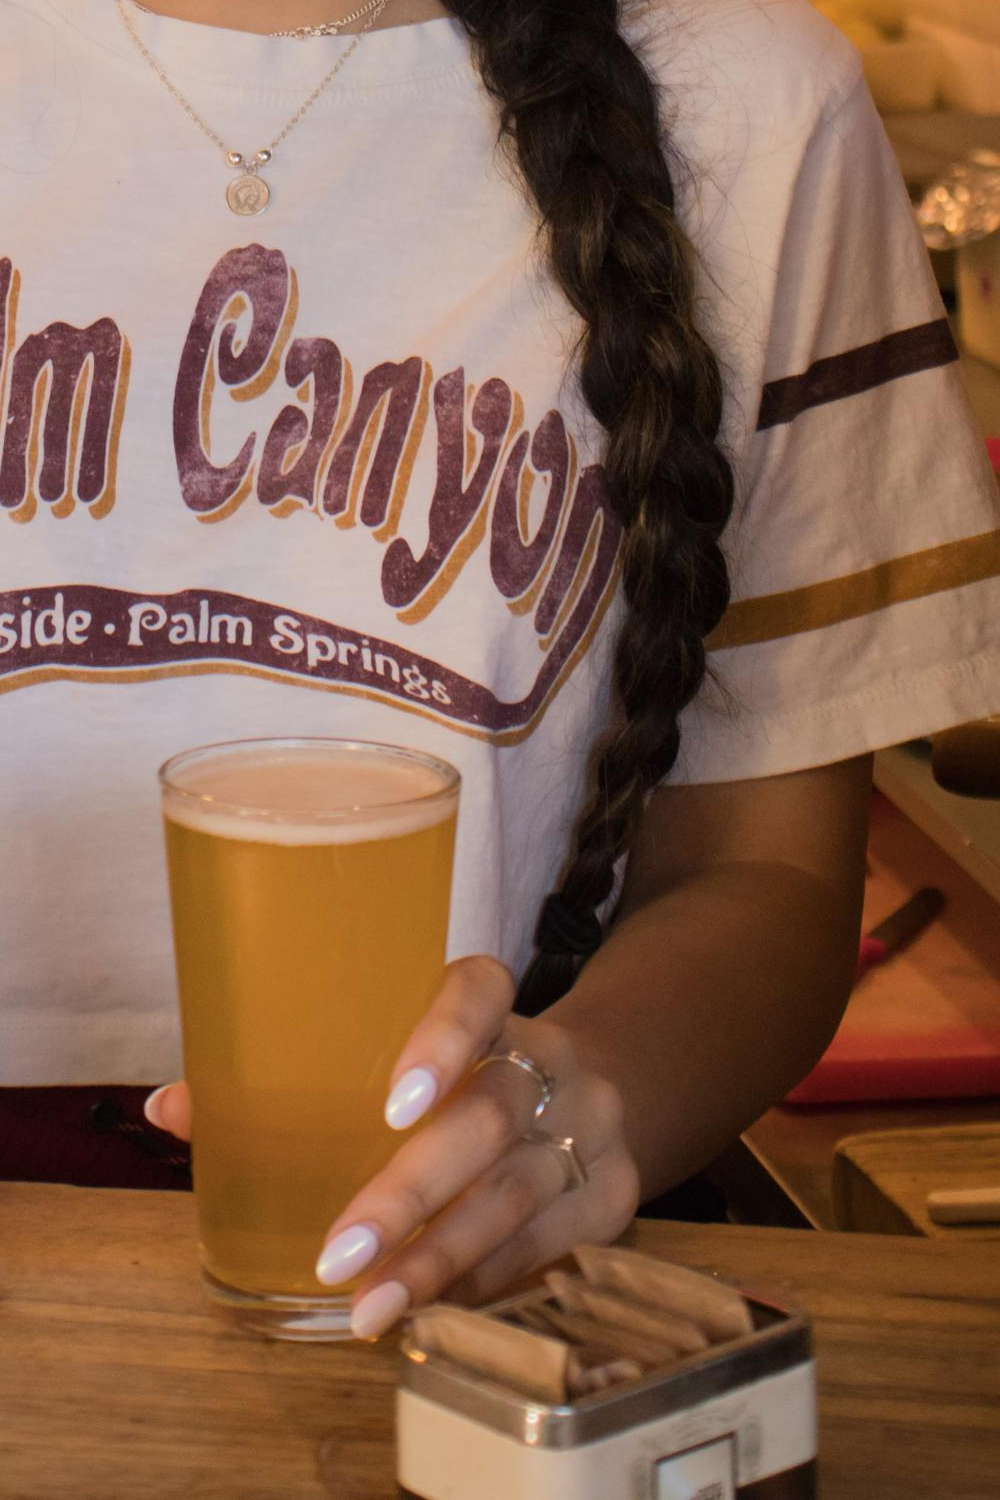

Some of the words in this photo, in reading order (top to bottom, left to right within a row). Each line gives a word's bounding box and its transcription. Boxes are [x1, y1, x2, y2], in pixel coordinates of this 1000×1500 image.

[173, 242, 626, 650] Canyon
[128, 599, 253, 647] Palm
[270, 614, 452, 705] Springs
